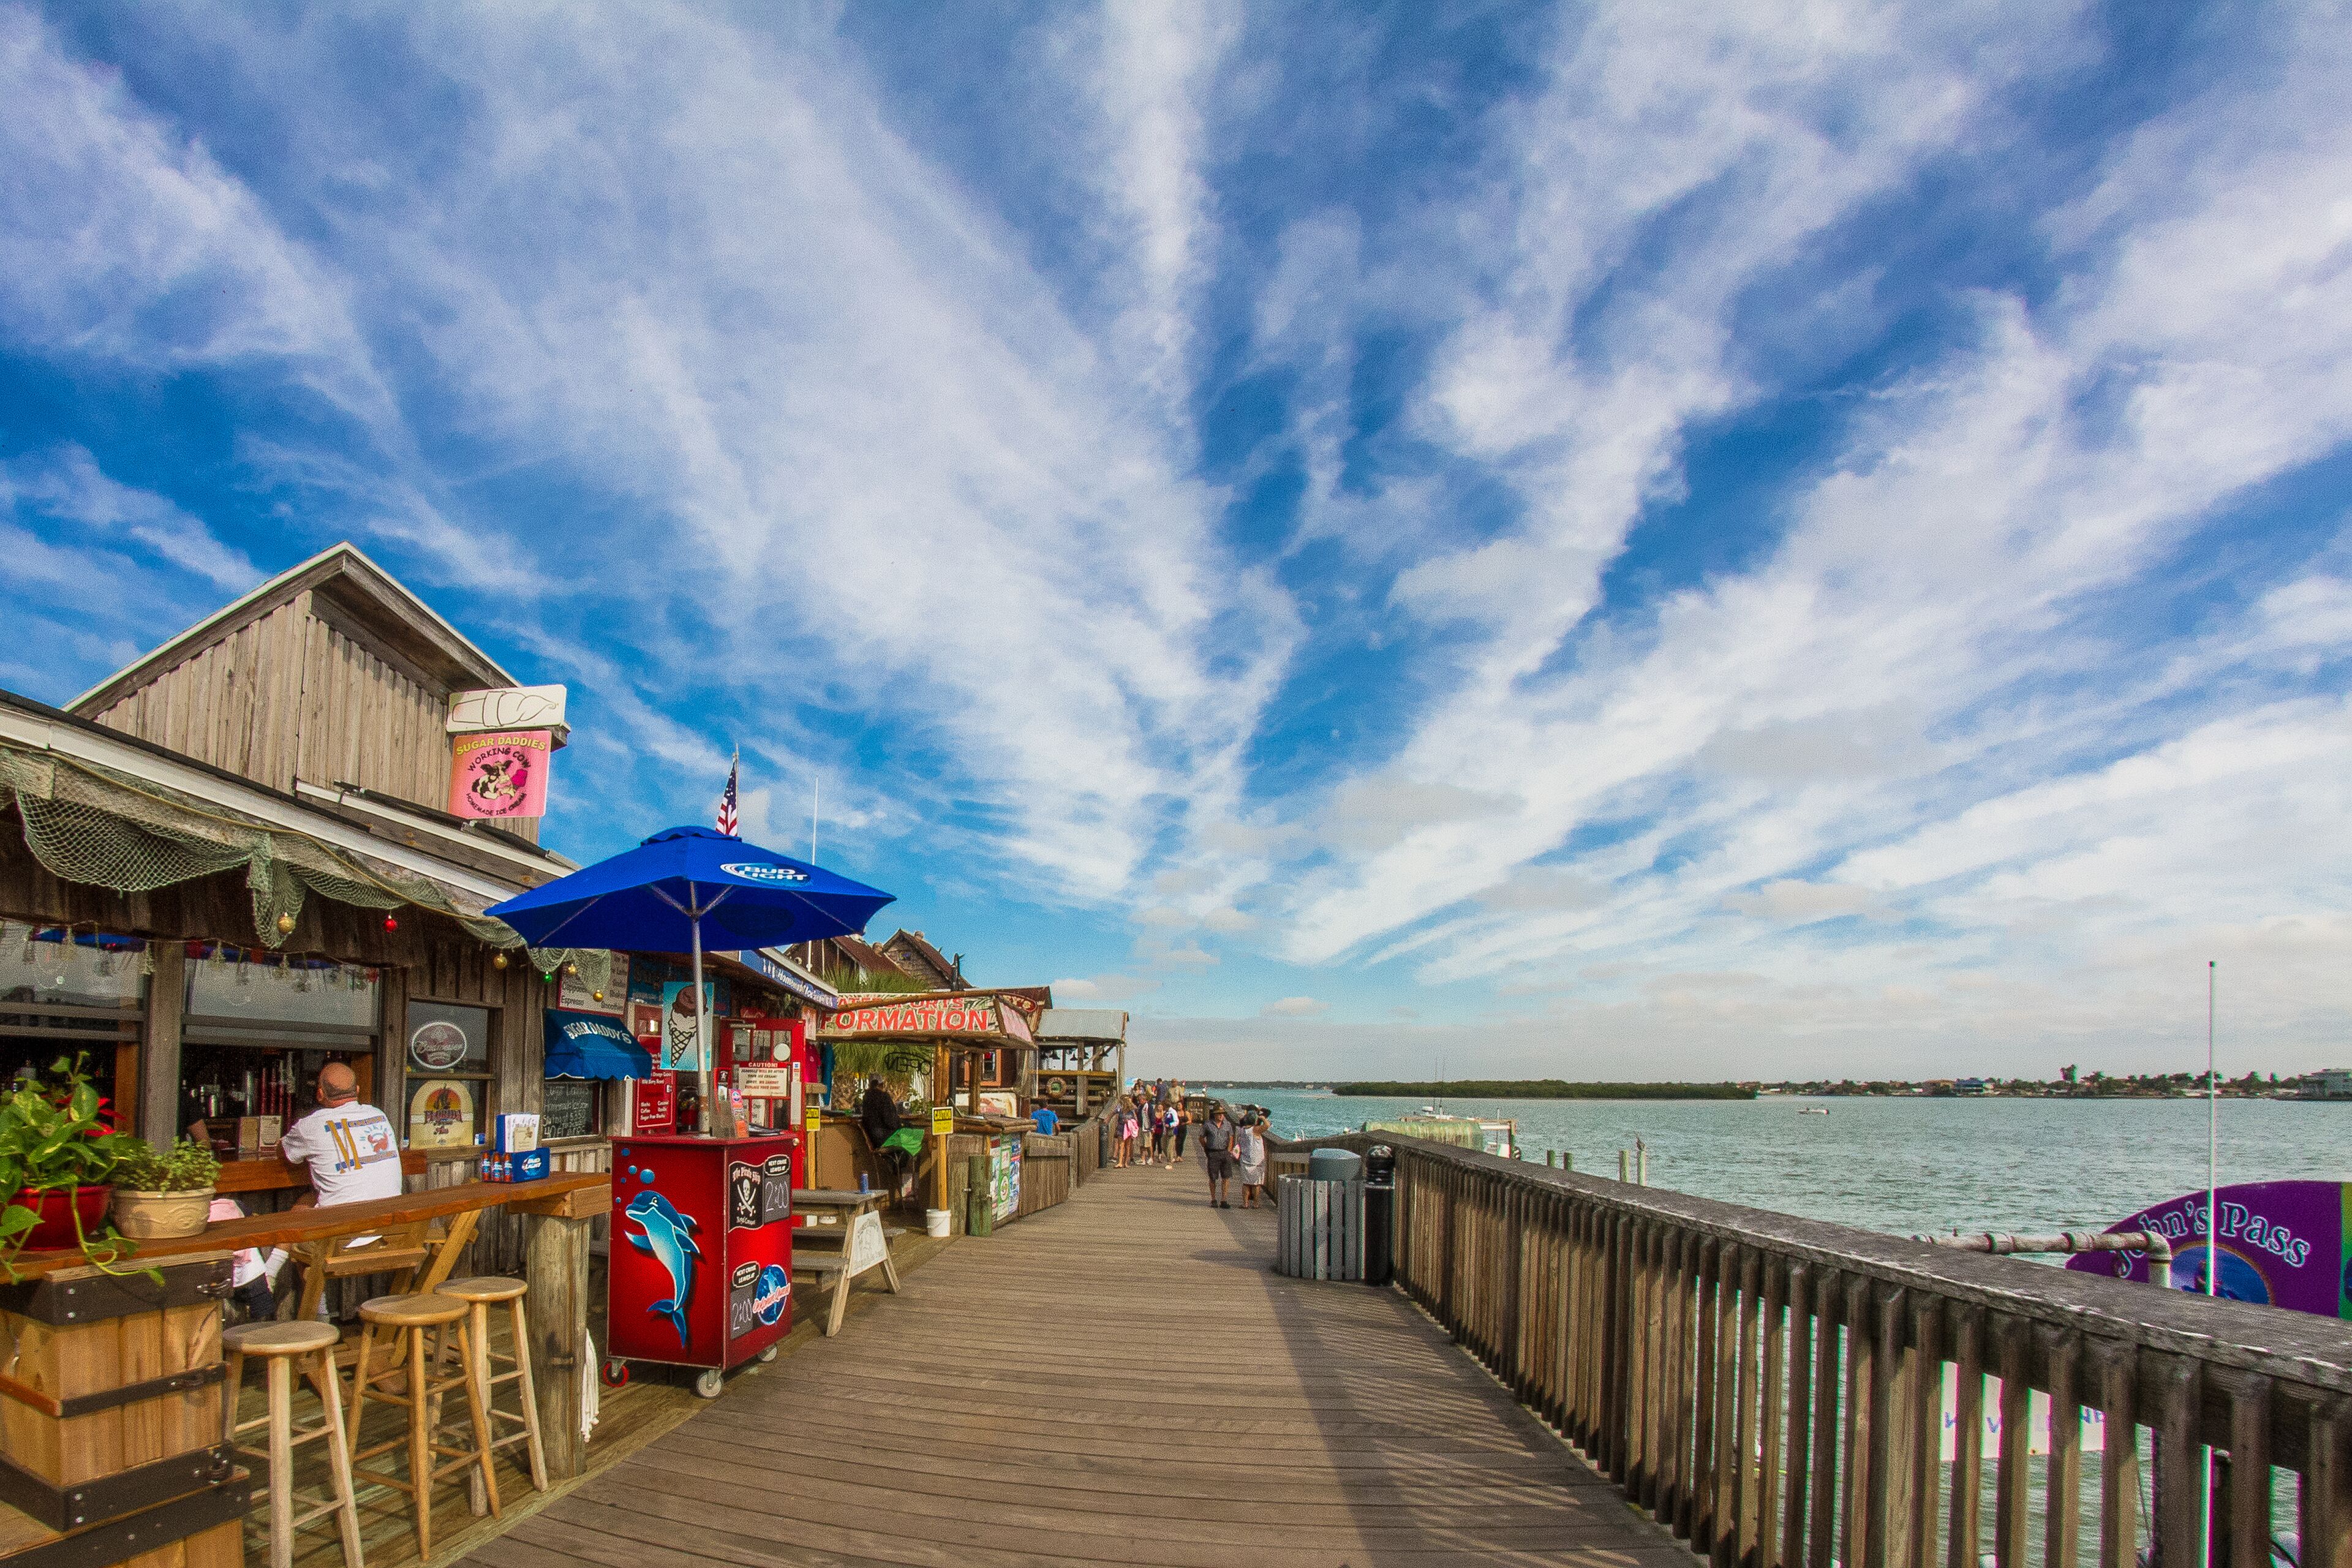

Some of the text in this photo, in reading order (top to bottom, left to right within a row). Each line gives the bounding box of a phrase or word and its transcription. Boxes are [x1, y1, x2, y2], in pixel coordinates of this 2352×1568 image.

[456, 737, 546, 755] SUGAR DADDIES
[468, 747, 531, 772] WORKING COW
[466, 793, 493, 816] HOMEMADE
[508, 793, 527, 811] CREAM
[739, 870, 808, 881] LIGHT
[745, 866, 796, 875] BUD
[562, 995, 584, 1006] Espresso
[821, 1009, 989, 1031] FORMATION
[563, 1022, 632, 1044] SUGAR DADDY'S
[765, 1181, 789, 1212] 2:00
[2220, 1202, 2310, 1267] Pass
[732, 1298, 752, 1330] 2:00
